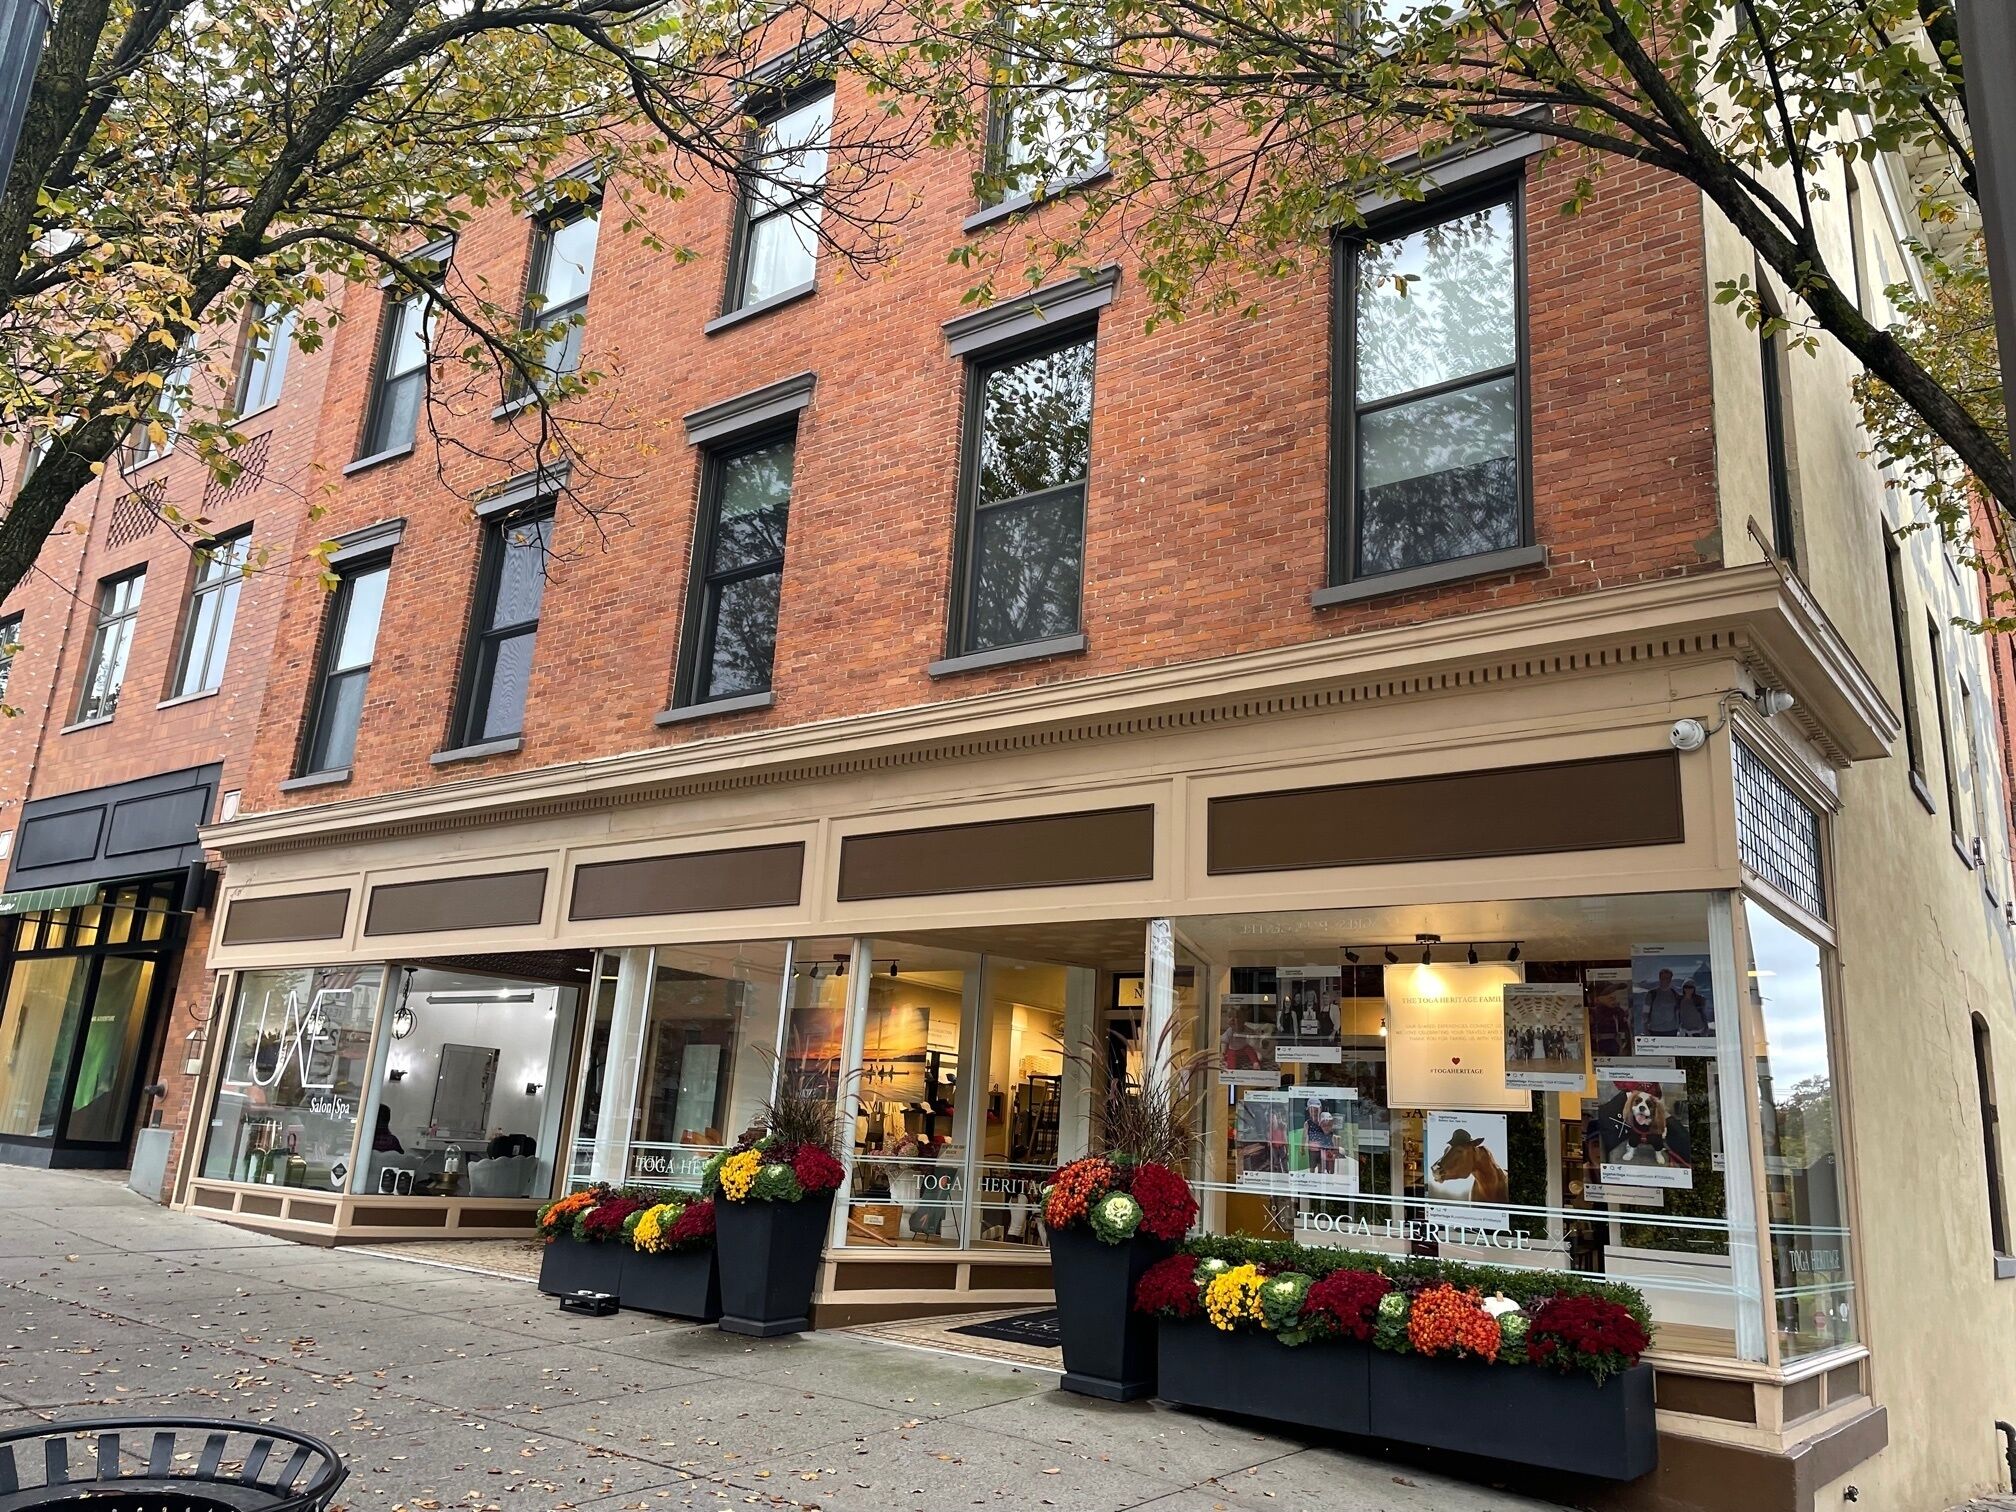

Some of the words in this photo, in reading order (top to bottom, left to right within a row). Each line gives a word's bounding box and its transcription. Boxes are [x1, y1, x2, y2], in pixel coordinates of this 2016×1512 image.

[1440, 996, 1478, 1004] HERITAGE
[1479, 995, 1503, 1003] FAMIL
[226, 989, 351, 1088] LUXE
[637, 1157, 675, 1174] TOGA
[913, 1174, 963, 1191] TOGA
[1296, 1210, 1374, 1237] TOGA
[1384, 1218, 1532, 1251] HERITAGE
[1789, 1250, 1810, 1272] TOGA
